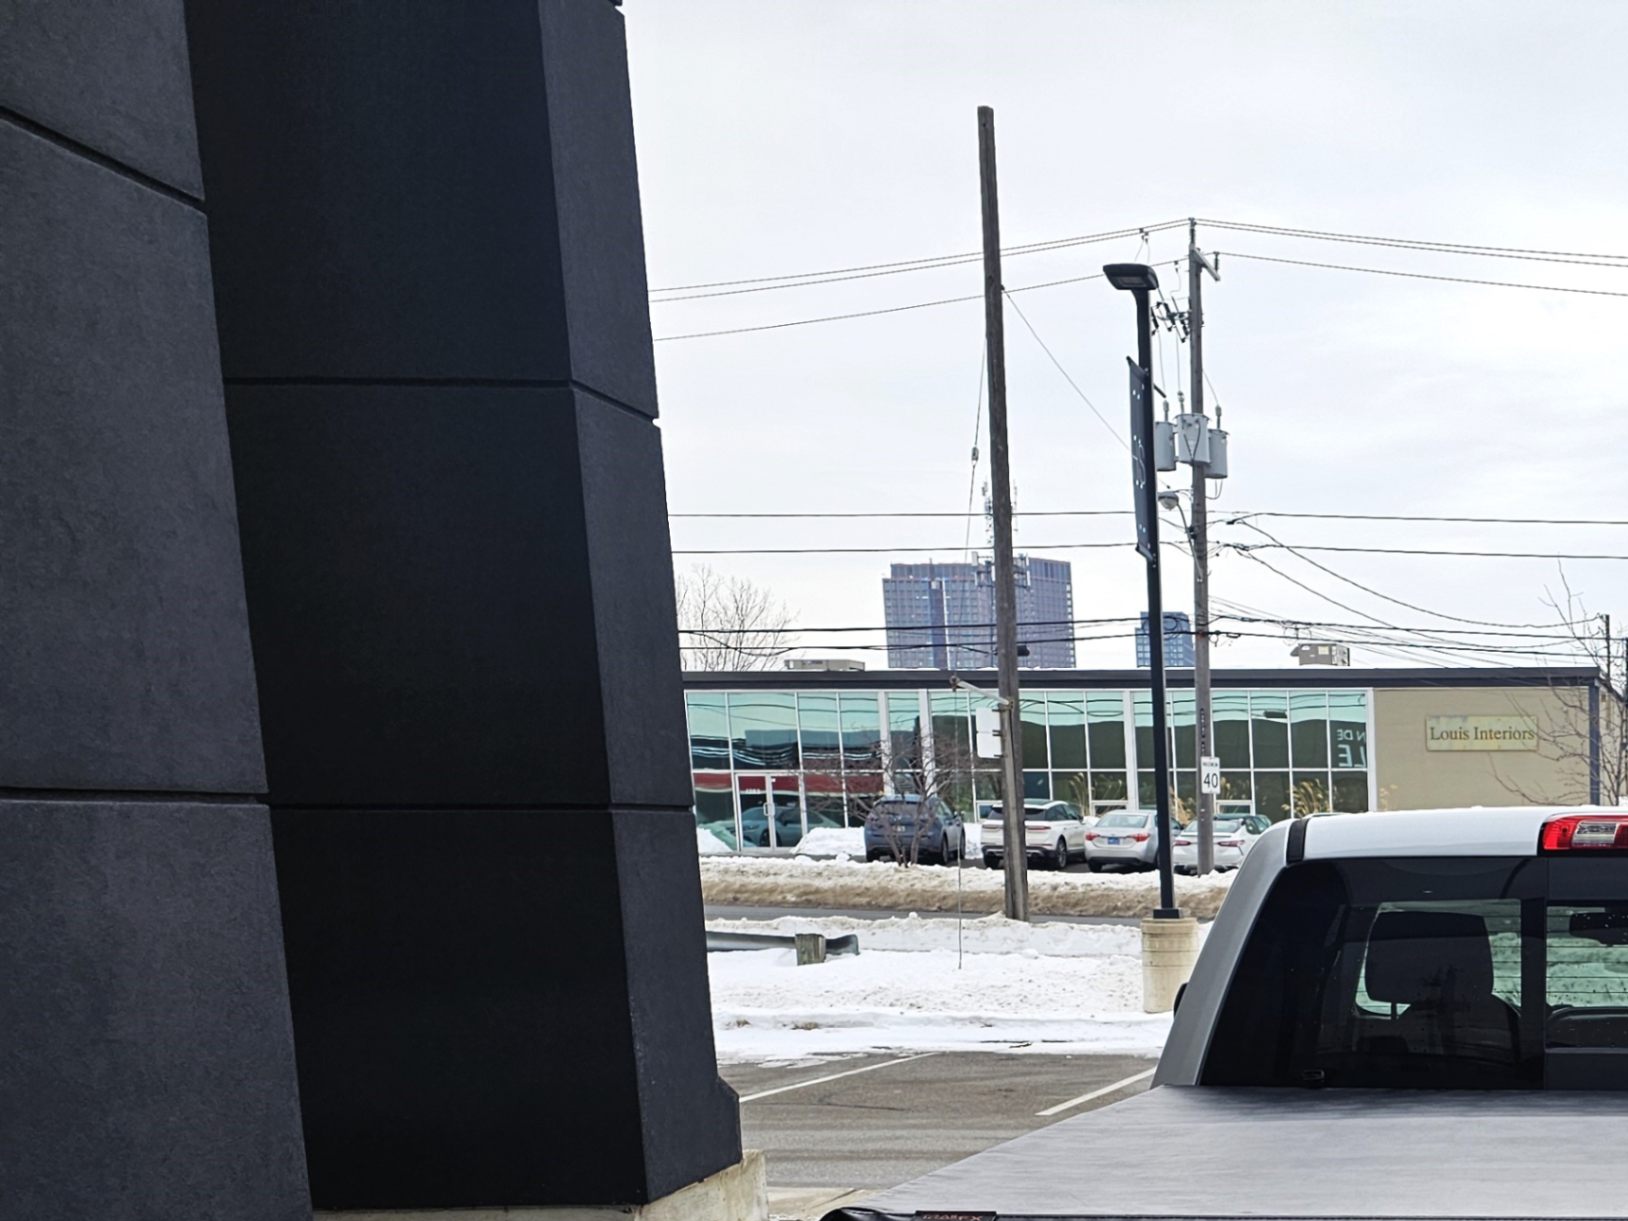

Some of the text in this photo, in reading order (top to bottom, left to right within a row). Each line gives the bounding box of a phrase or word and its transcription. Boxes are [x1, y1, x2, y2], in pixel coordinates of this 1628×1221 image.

[1430, 726, 1535, 740] Louis Interiors
[1203, 772, 1218, 789] 40
